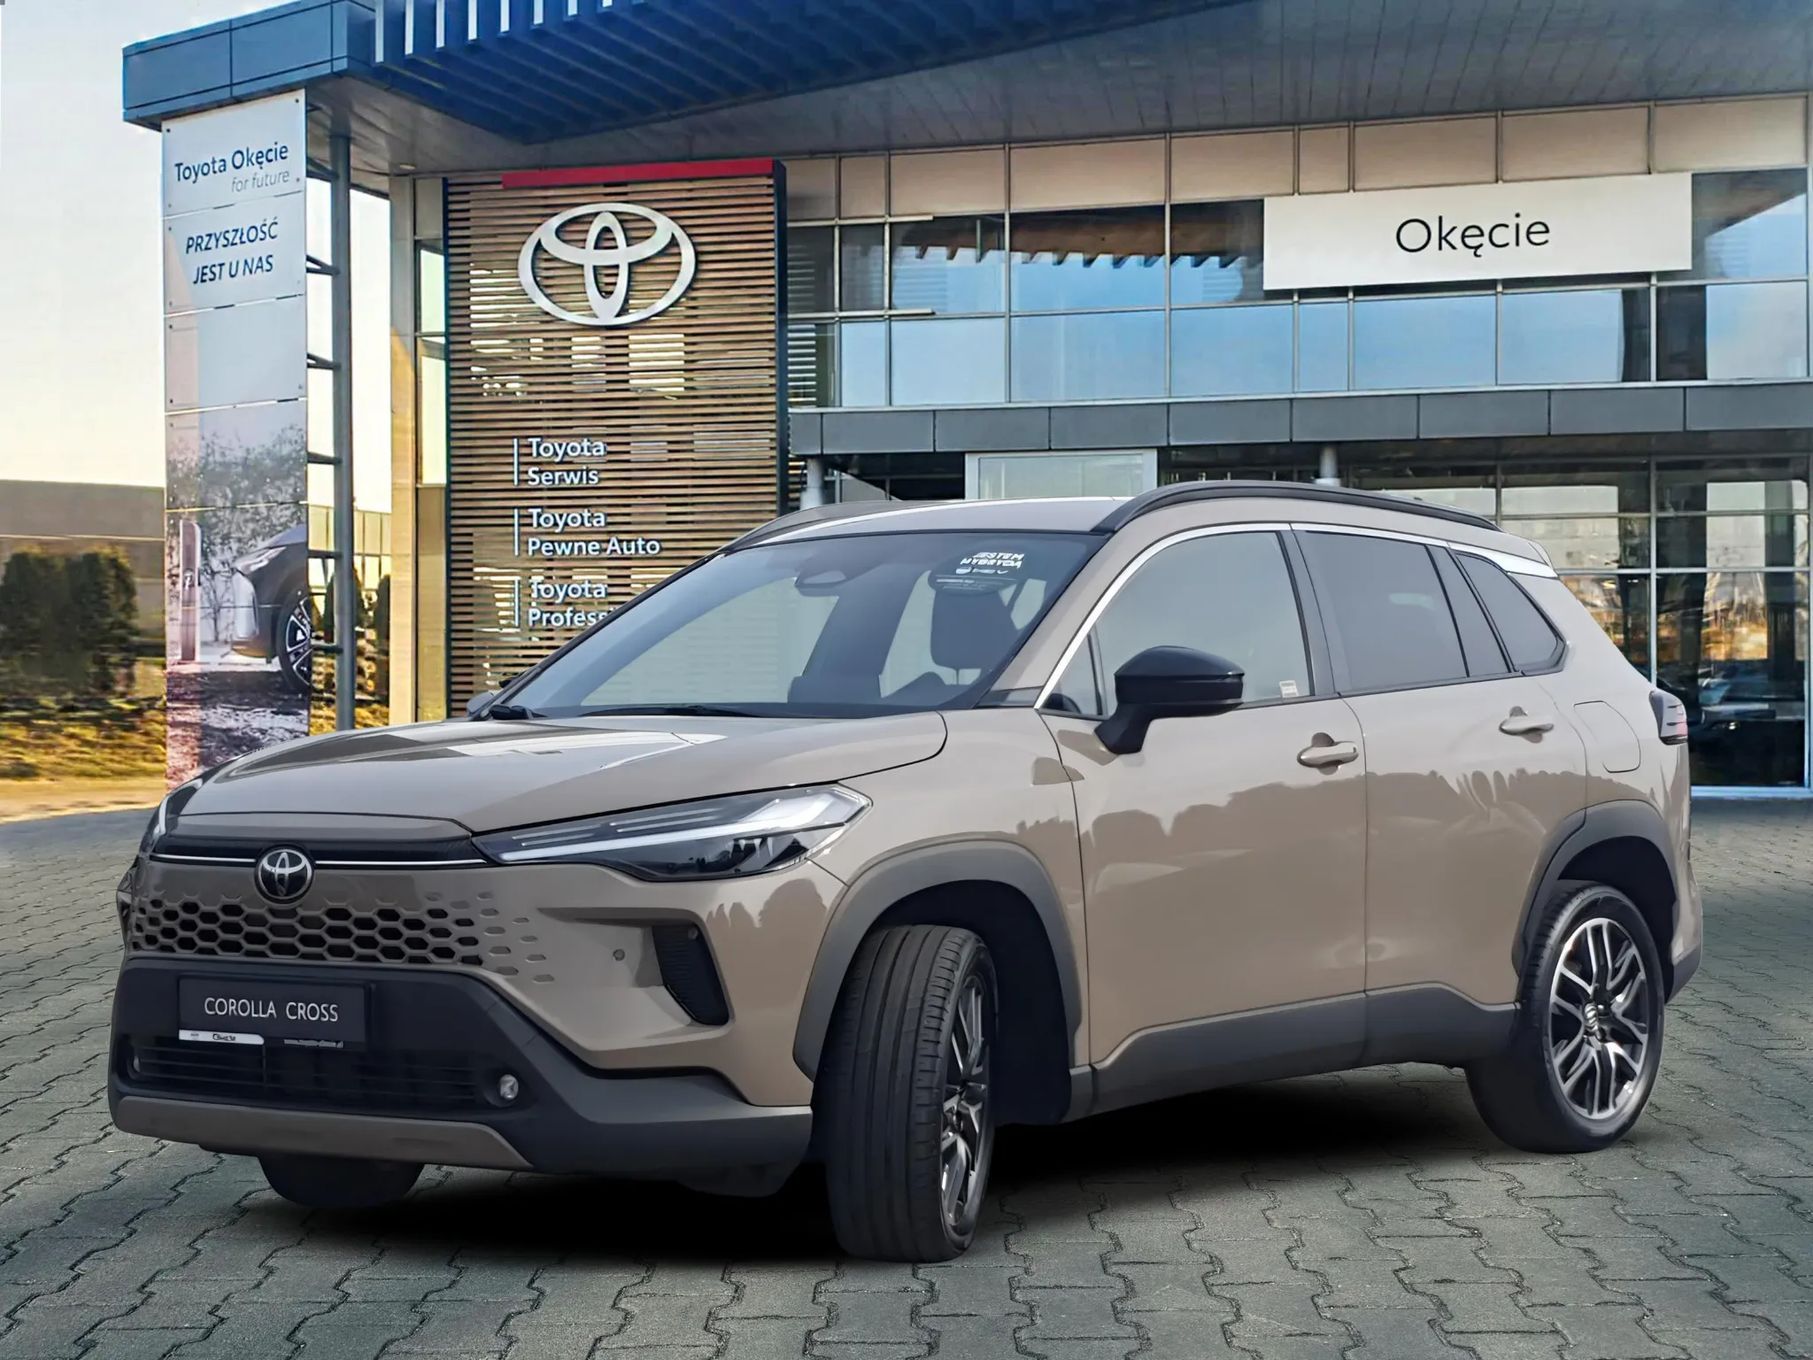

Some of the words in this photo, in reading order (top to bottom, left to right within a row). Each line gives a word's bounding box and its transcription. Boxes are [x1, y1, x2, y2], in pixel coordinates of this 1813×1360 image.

[175, 156, 227, 183] Toyota
[231, 141, 289, 170] Okęcie
[231, 177, 249, 193] for
[251, 170, 290, 188] future
[185, 216, 279, 254] PRZYSZŁOŚĆ
[1396, 212, 1550, 257] Okęcie
[193, 263, 225, 284] JEST
[228, 261, 240, 278] U
[242, 254, 274, 276] NAS
[527, 437, 606, 462] Toyota
[527, 466, 599, 486] Serwis
[527, 508, 606, 533] Toyota
[527, 537, 600, 556] Pewne
[606, 536, 661, 555] Auto
[528, 579, 606, 604] Toyota
[528, 606, 614, 627] Profess
[204, 997, 277, 1018] COROLLA
[285, 1001, 338, 1022] CROSS
